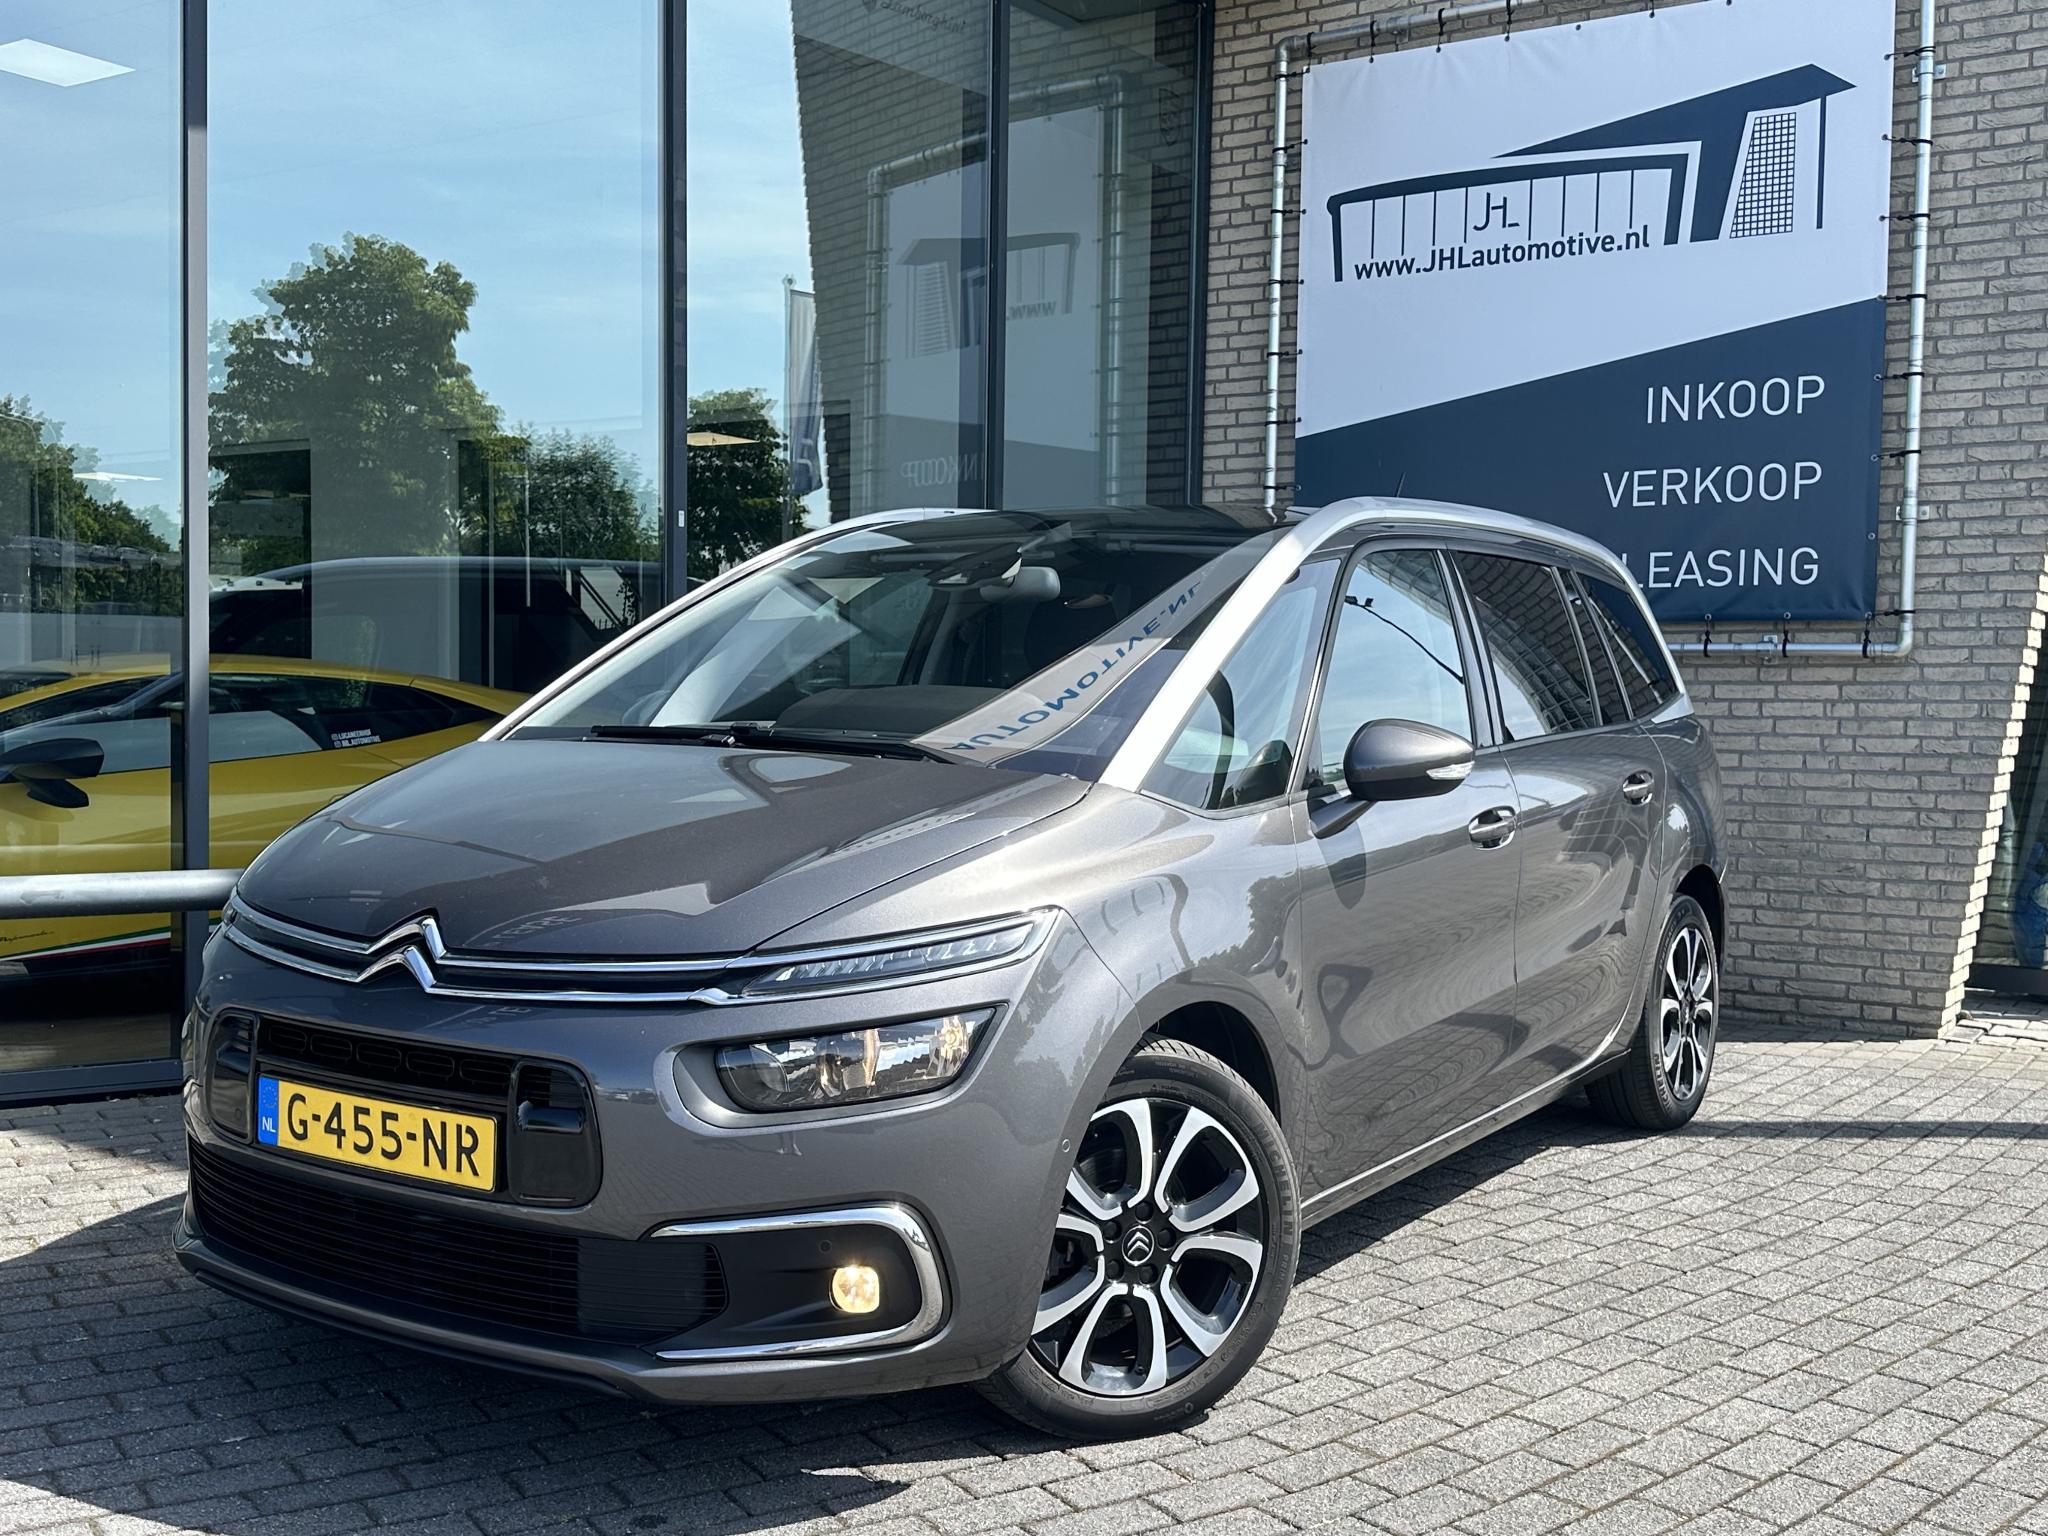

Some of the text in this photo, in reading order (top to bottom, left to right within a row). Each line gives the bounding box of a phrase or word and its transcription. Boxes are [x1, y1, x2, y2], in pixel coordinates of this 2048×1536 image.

[1354, 225, 1650, 280] www.JHLautomotive.nl
[1647, 375, 1825, 424] INKOOP
[1603, 461, 1822, 508] VERKOOP
[261, 1116, 276, 1133] NL
[287, 1092, 480, 1177] G-455-NR
